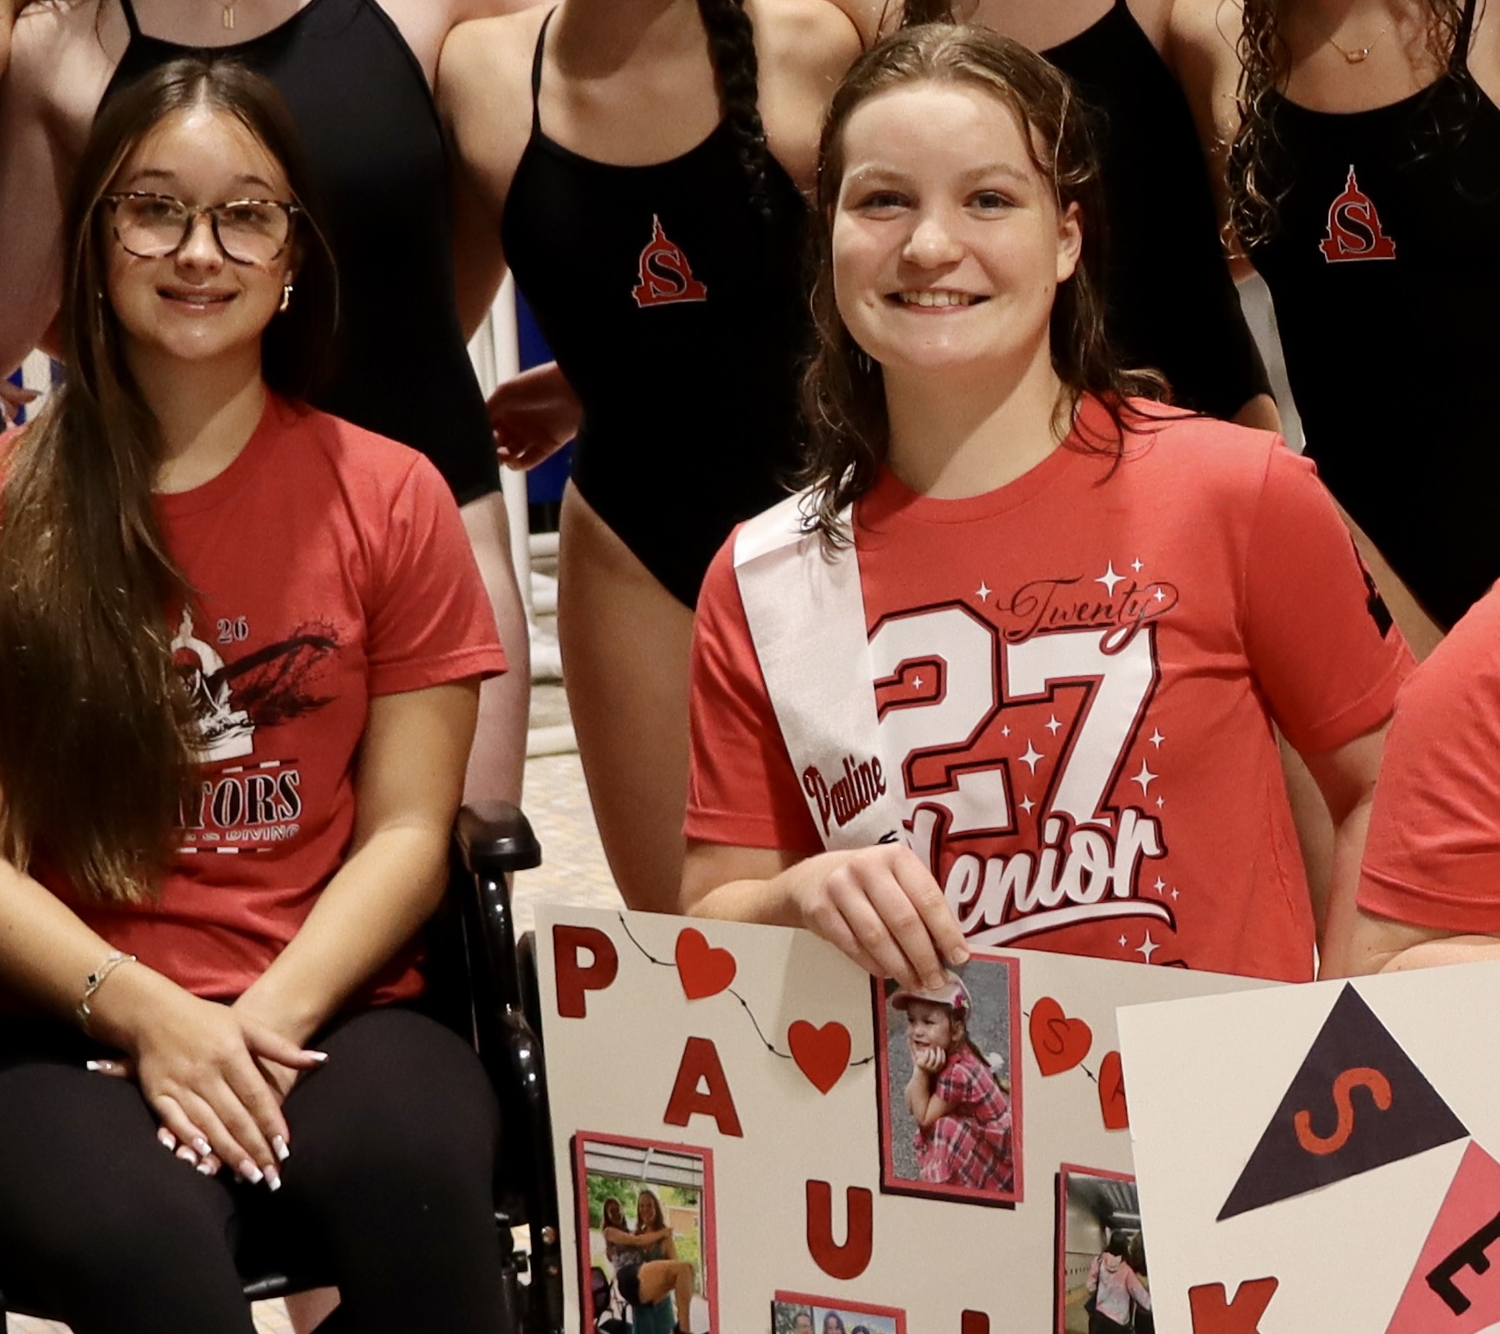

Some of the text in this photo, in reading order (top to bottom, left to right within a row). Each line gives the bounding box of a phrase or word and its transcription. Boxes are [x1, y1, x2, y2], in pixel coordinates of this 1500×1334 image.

[1334, 200, 1376, 255] S
[646, 248, 688, 299] S
[216, 615, 249, 644] 26
[996, 577, 1180, 655] Twenty
[867, 599, 1161, 839] 27
[176, 769, 302, 829] TORS
[803, 753, 889, 837] Pauline
[225, 823, 301, 842] DIVING
